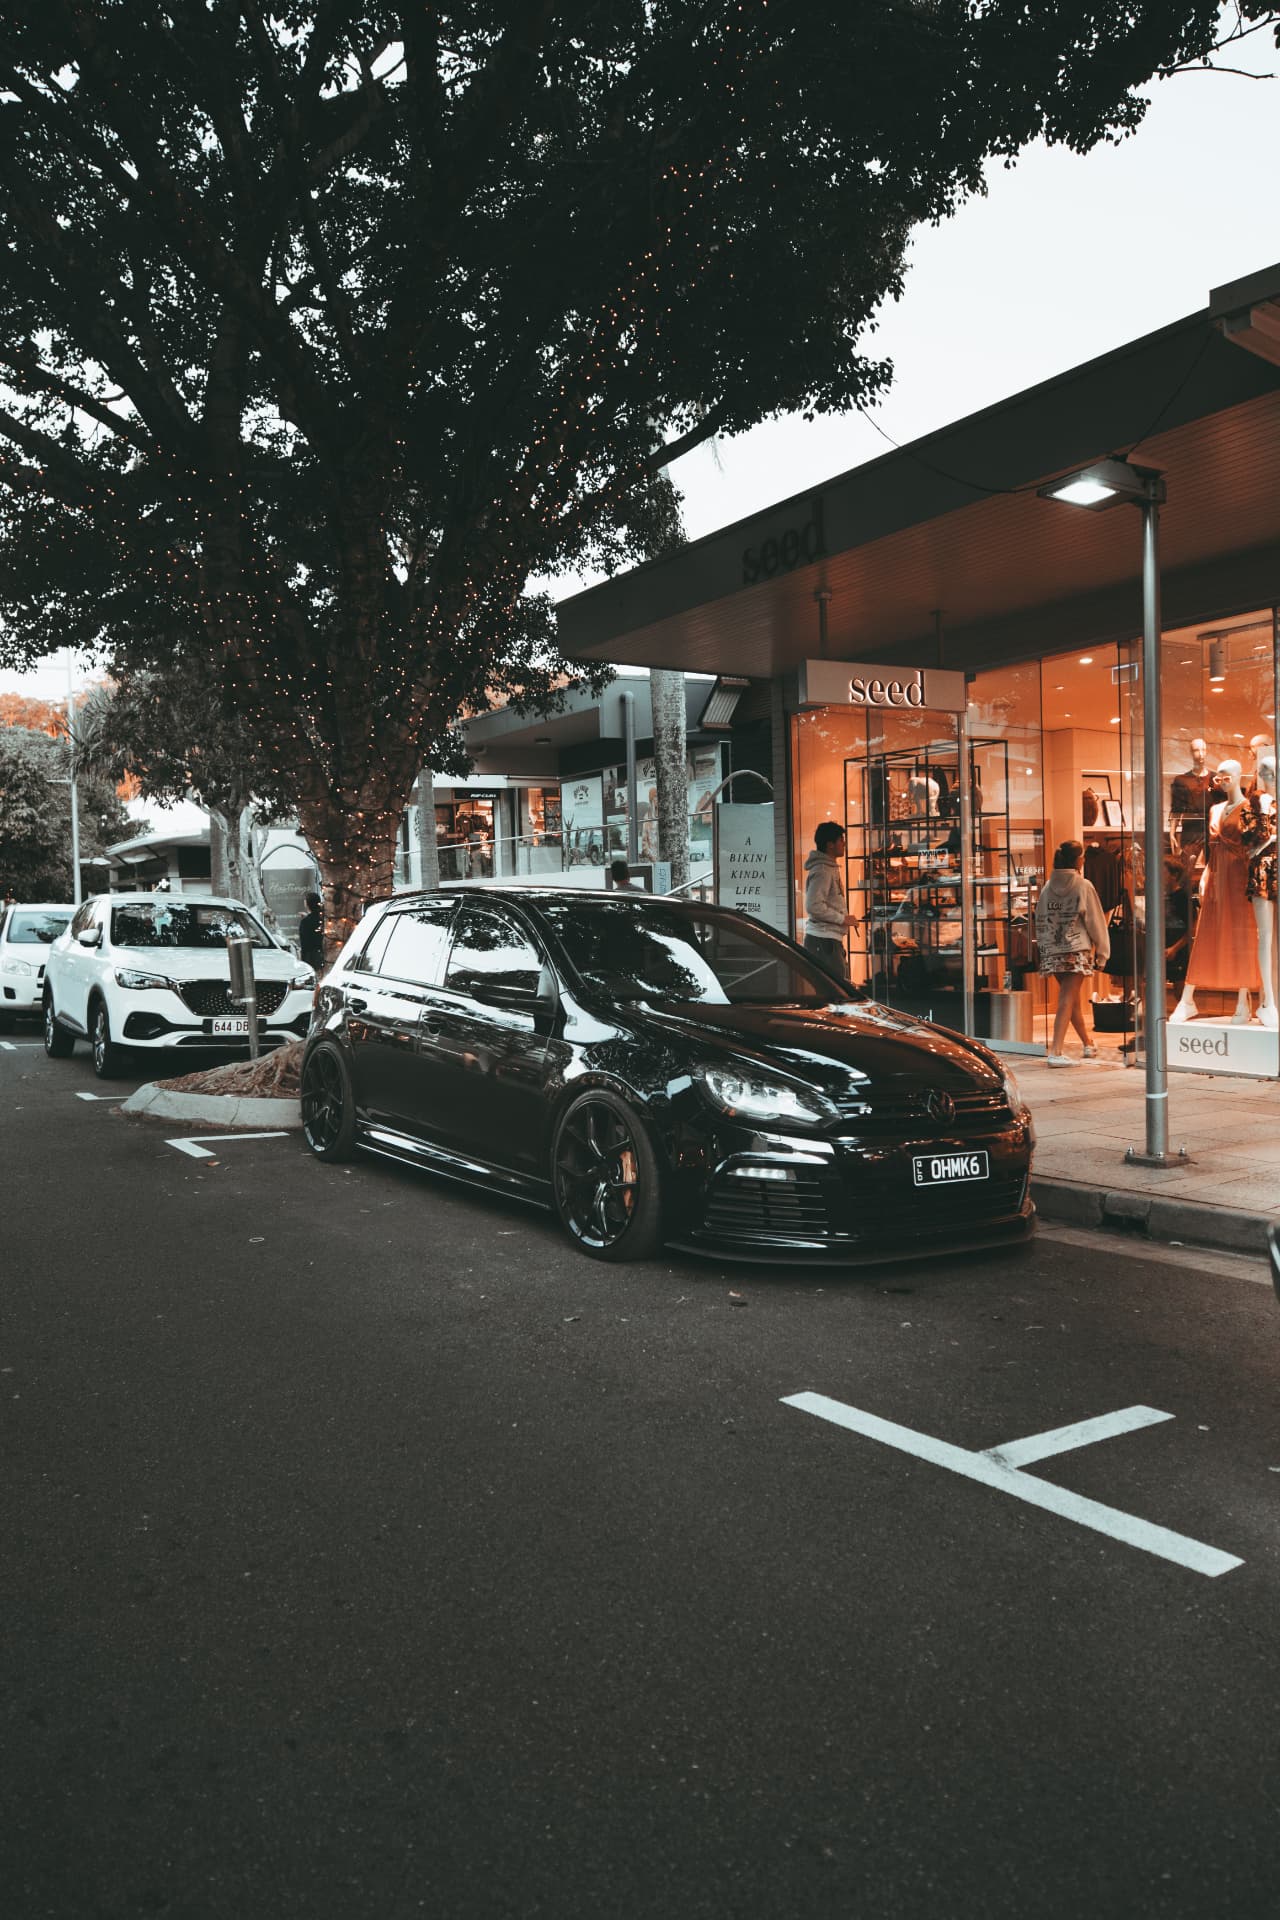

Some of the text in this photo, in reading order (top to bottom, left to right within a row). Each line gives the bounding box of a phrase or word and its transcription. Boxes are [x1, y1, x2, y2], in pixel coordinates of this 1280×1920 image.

[742, 497, 826, 584] seed
[848, 670, 928, 707] seed
[745, 836, 751, 846] A
[729, 853, 767, 863] BIKINI
[731, 870, 765, 879] KINDA
[735, 886, 761, 895] LIFE
[214, 1021, 232, 1032] 644
[1179, 1031, 1230, 1056] seed
